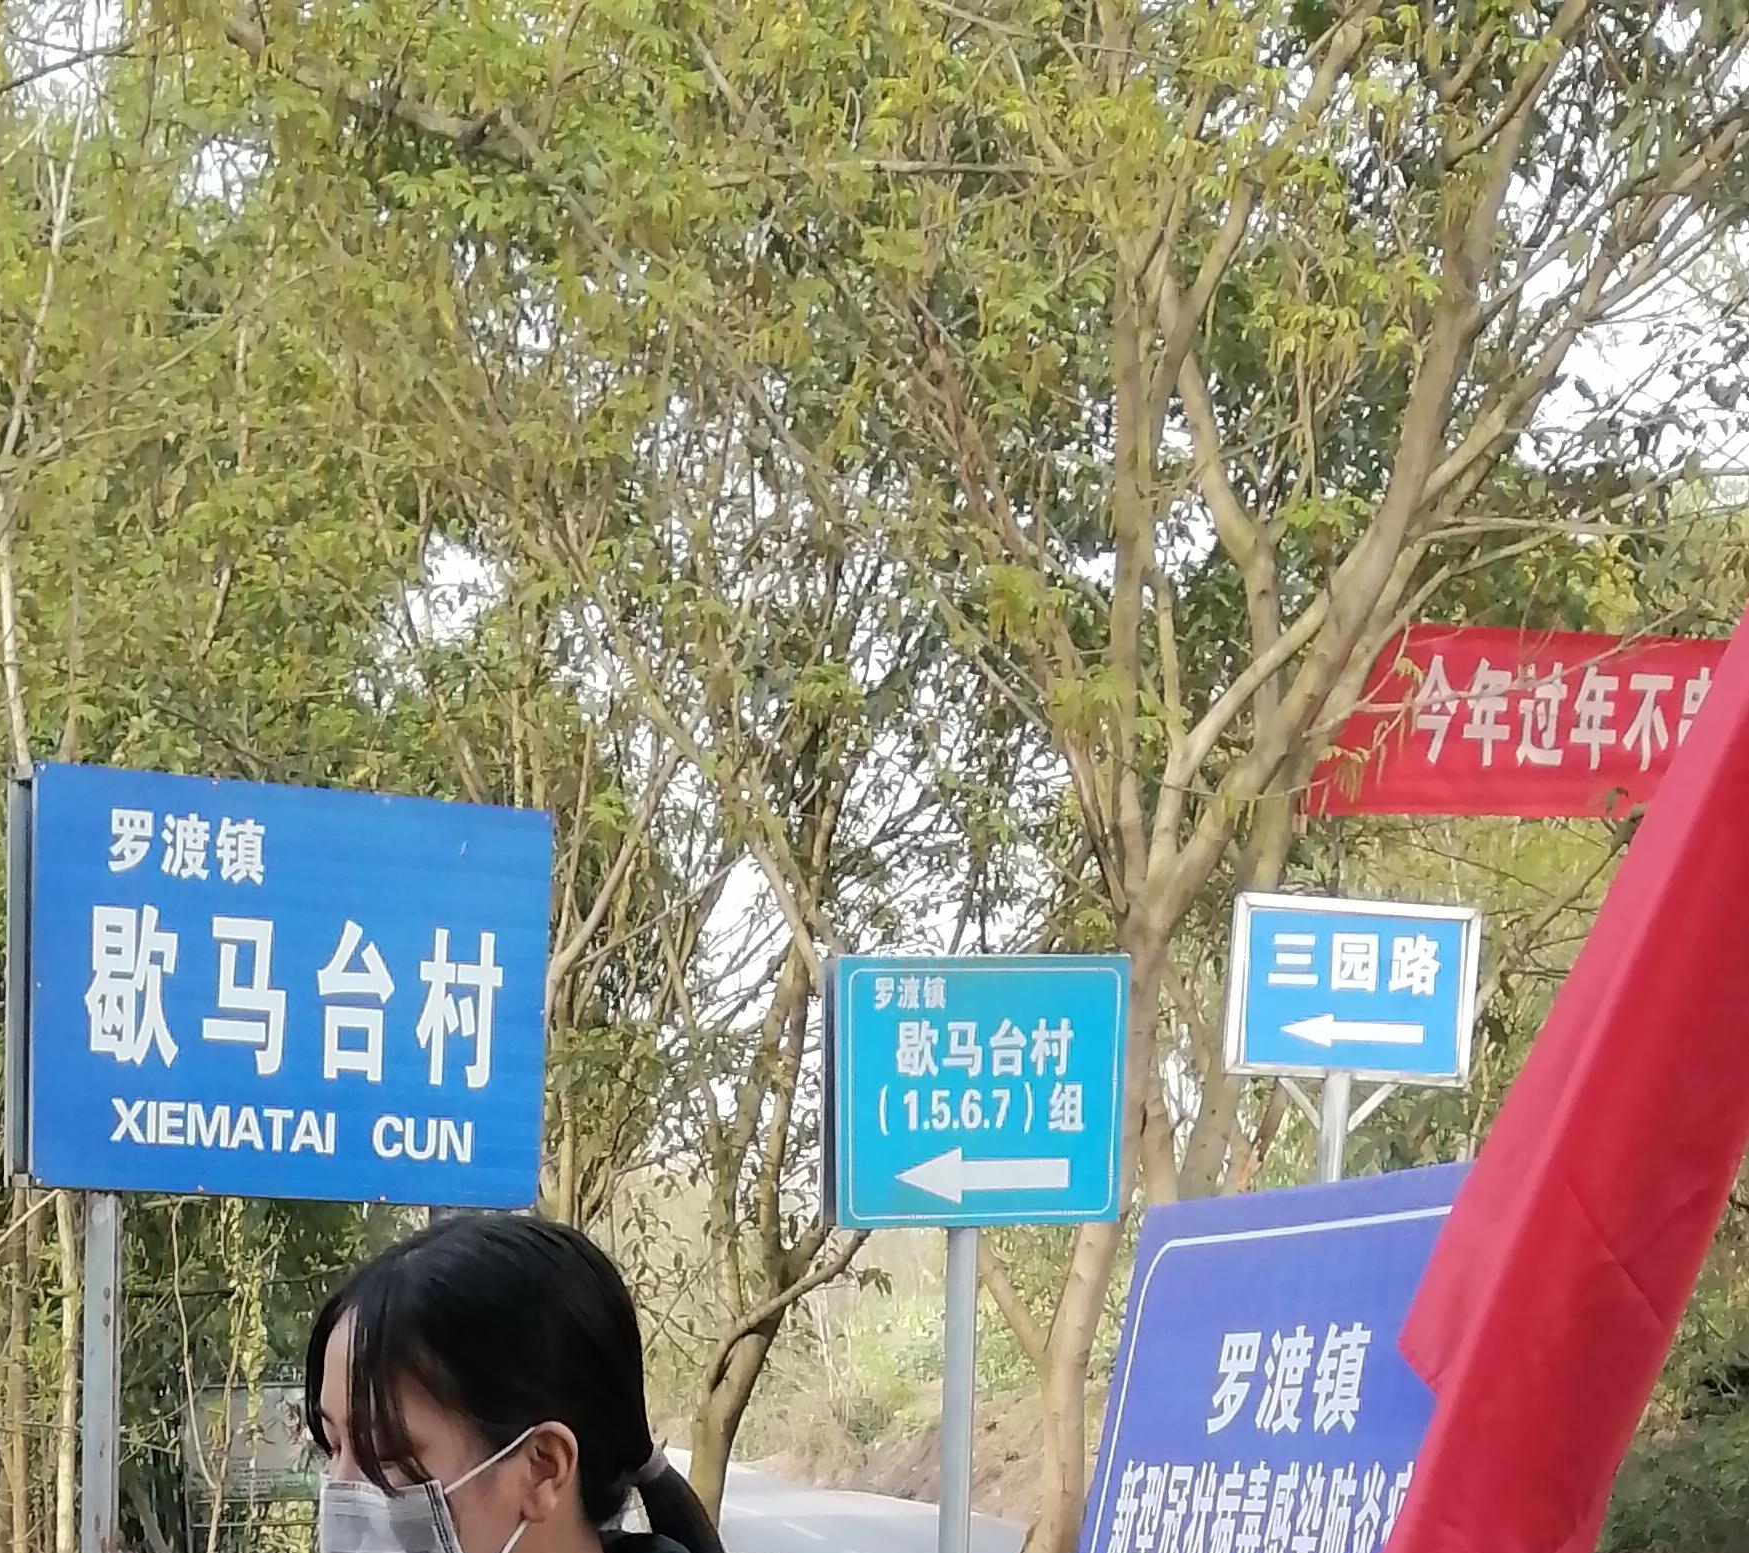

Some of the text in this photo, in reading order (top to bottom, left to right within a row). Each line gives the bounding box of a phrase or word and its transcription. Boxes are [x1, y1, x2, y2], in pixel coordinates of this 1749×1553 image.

[107, 807, 266, 884] 罗渡镇
[84, 904, 504, 1089] 歇马台村
[873, 975, 948, 1012] 罗渡镇
[1267, 932, 1442, 997] 三园路
[895, 1017, 1074, 1078] 歇马台村
[109, 1098, 474, 1163] XIEMATAI CUN
[1206, 1322, 1372, 1436] 罗渡镇
